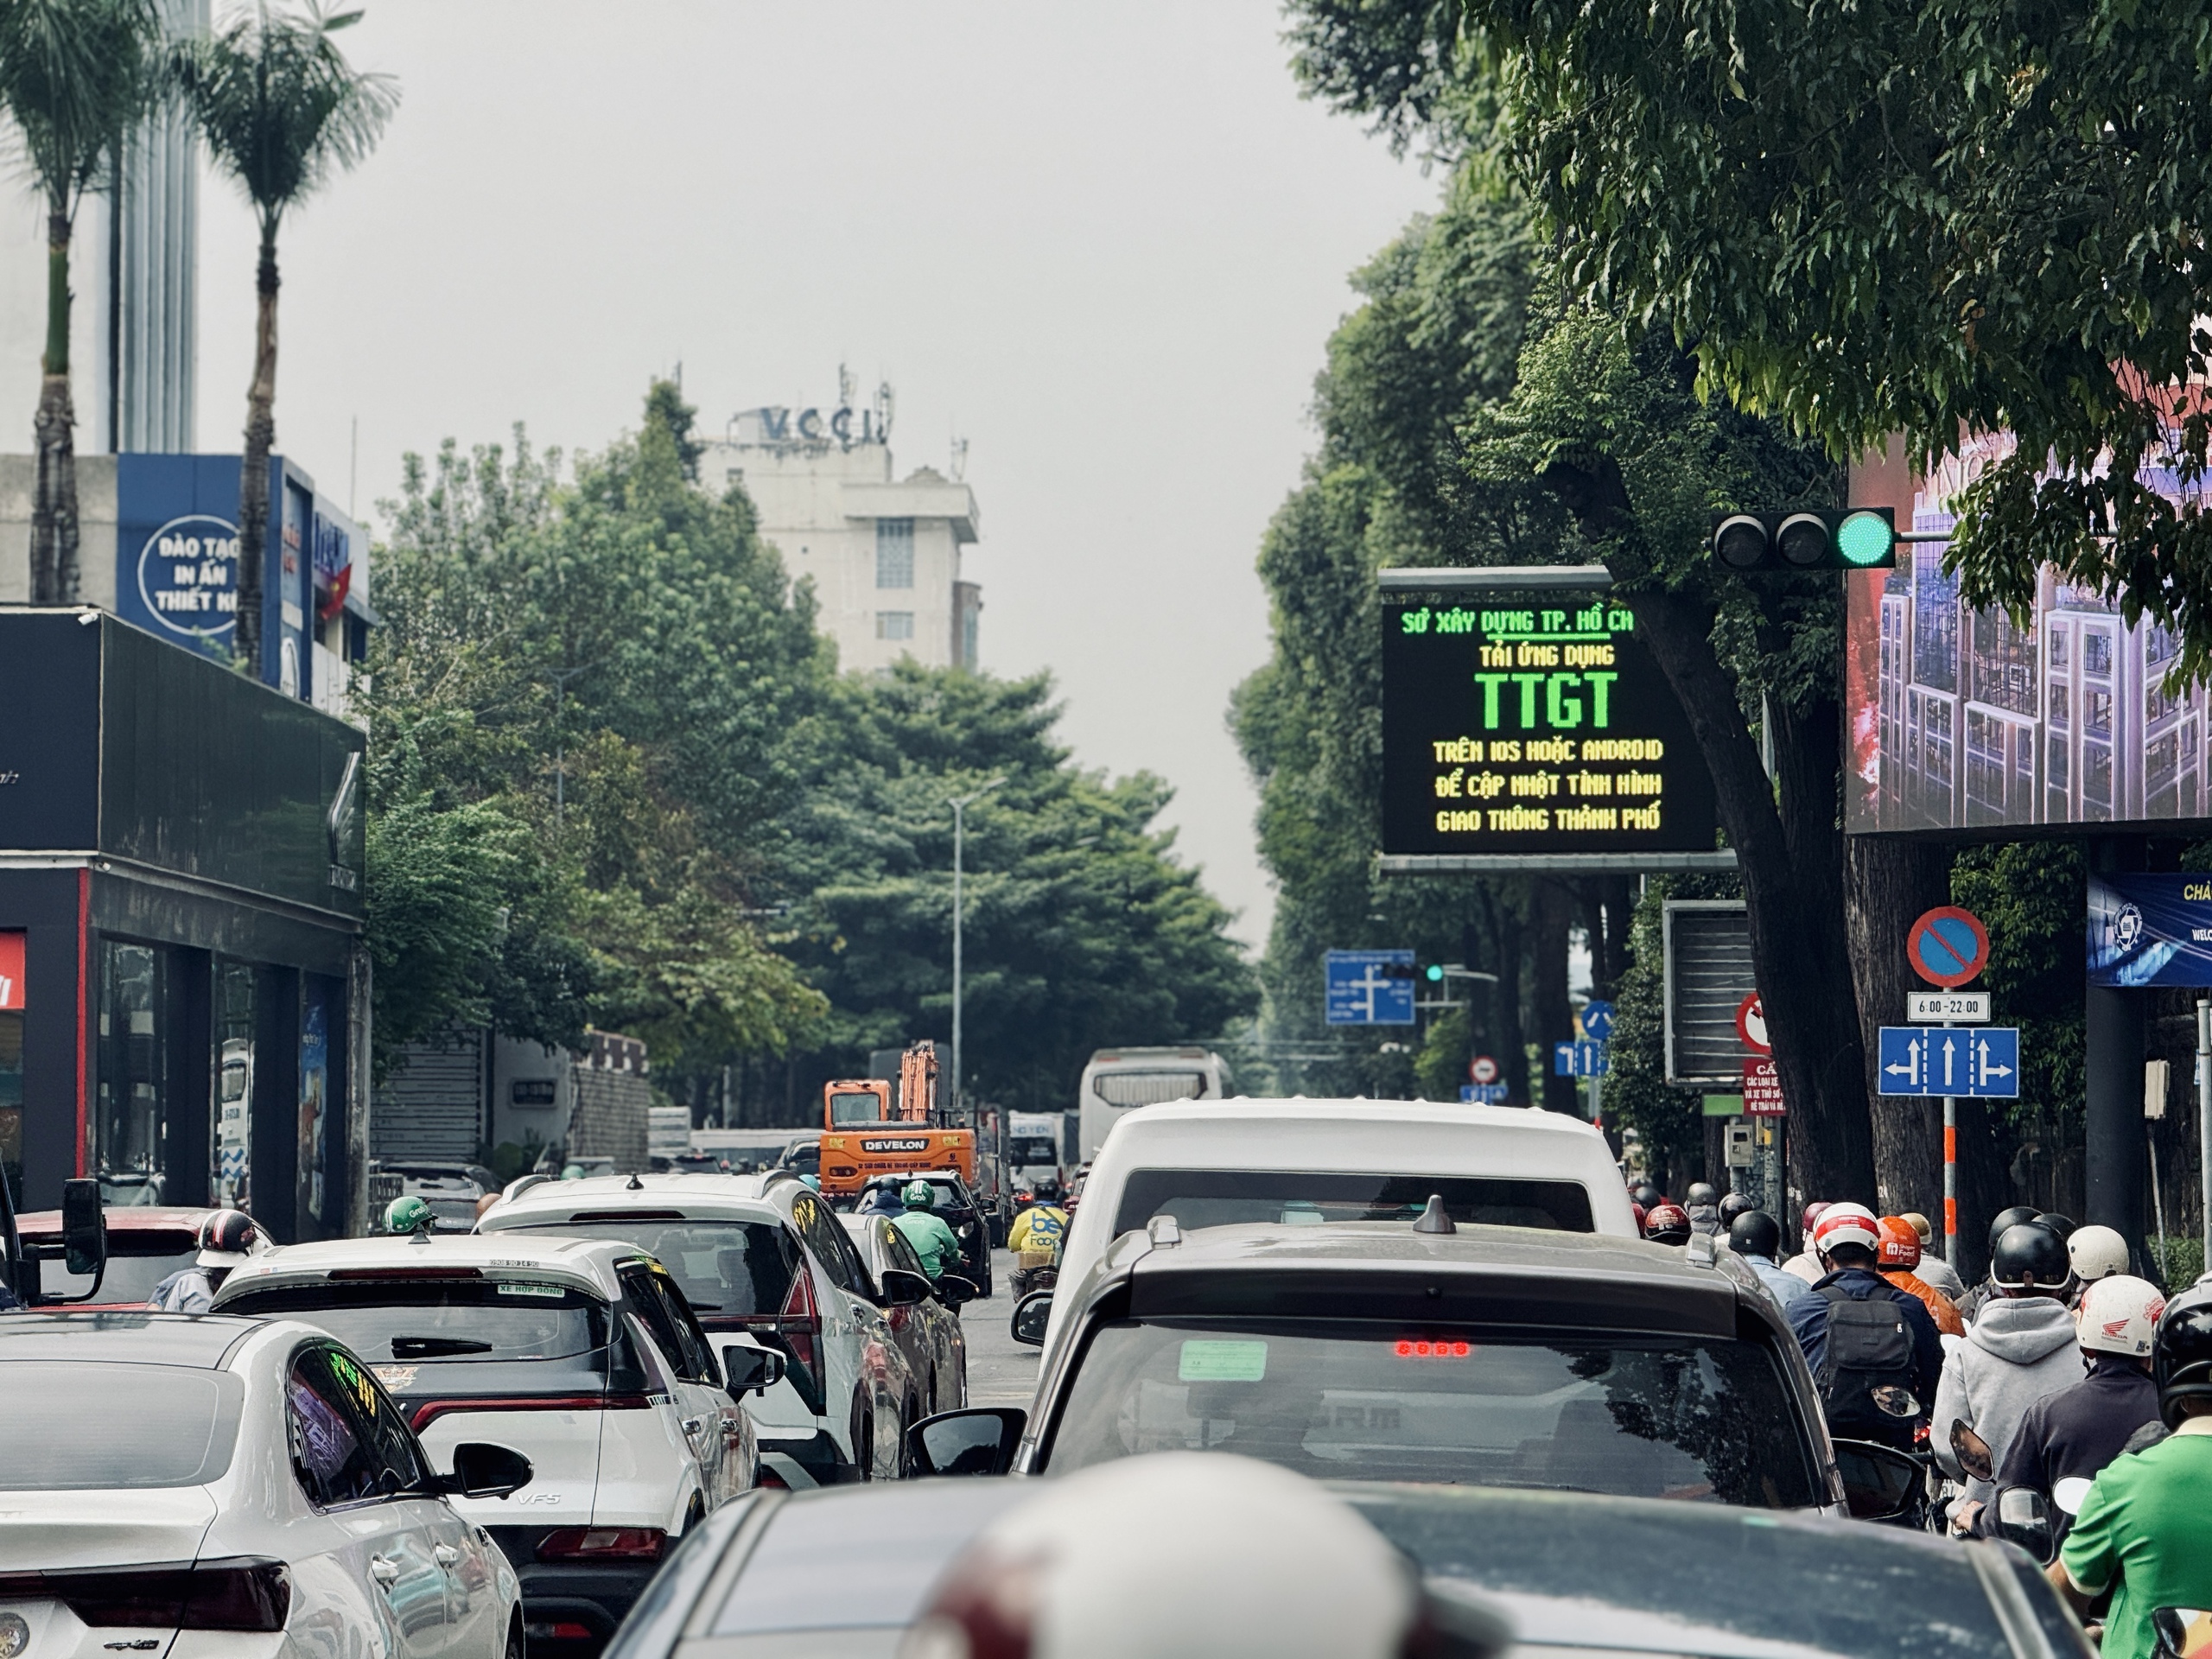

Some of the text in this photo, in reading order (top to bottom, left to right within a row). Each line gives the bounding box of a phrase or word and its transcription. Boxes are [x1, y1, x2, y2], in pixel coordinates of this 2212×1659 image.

[175, 558, 227, 585] IN ẤN
[155, 585, 213, 611] THIẾT
[1401, 607, 1430, 633] SỞ
[1435, 607, 1476, 633] XÂY
[1481, 610, 1535, 635] DỰNG
[1541, 610, 1572, 632] TP.
[1577, 602, 1604, 631] HỒ
[1478, 639, 1615, 669] TẢI ỨNG DỤNG
[1474, 671, 1618, 729] TTGT
[1433, 735, 1664, 765] TRÊN IOS HOẶC ANDROID
[1435, 767, 1662, 800] ĐỂ CẬP NHẬT TÌNH HÌNH
[1435, 799, 1662, 832] GIAO THÔNG THÀNH PHỐ
[2183, 880, 2212, 900] CHÀ
[865, 1140, 925, 1151] DEVELON
[410, 1205, 429, 1218] Grab
[1032, 1211, 1058, 1235] be
[2101, 1332, 2128, 1340] HONDA
